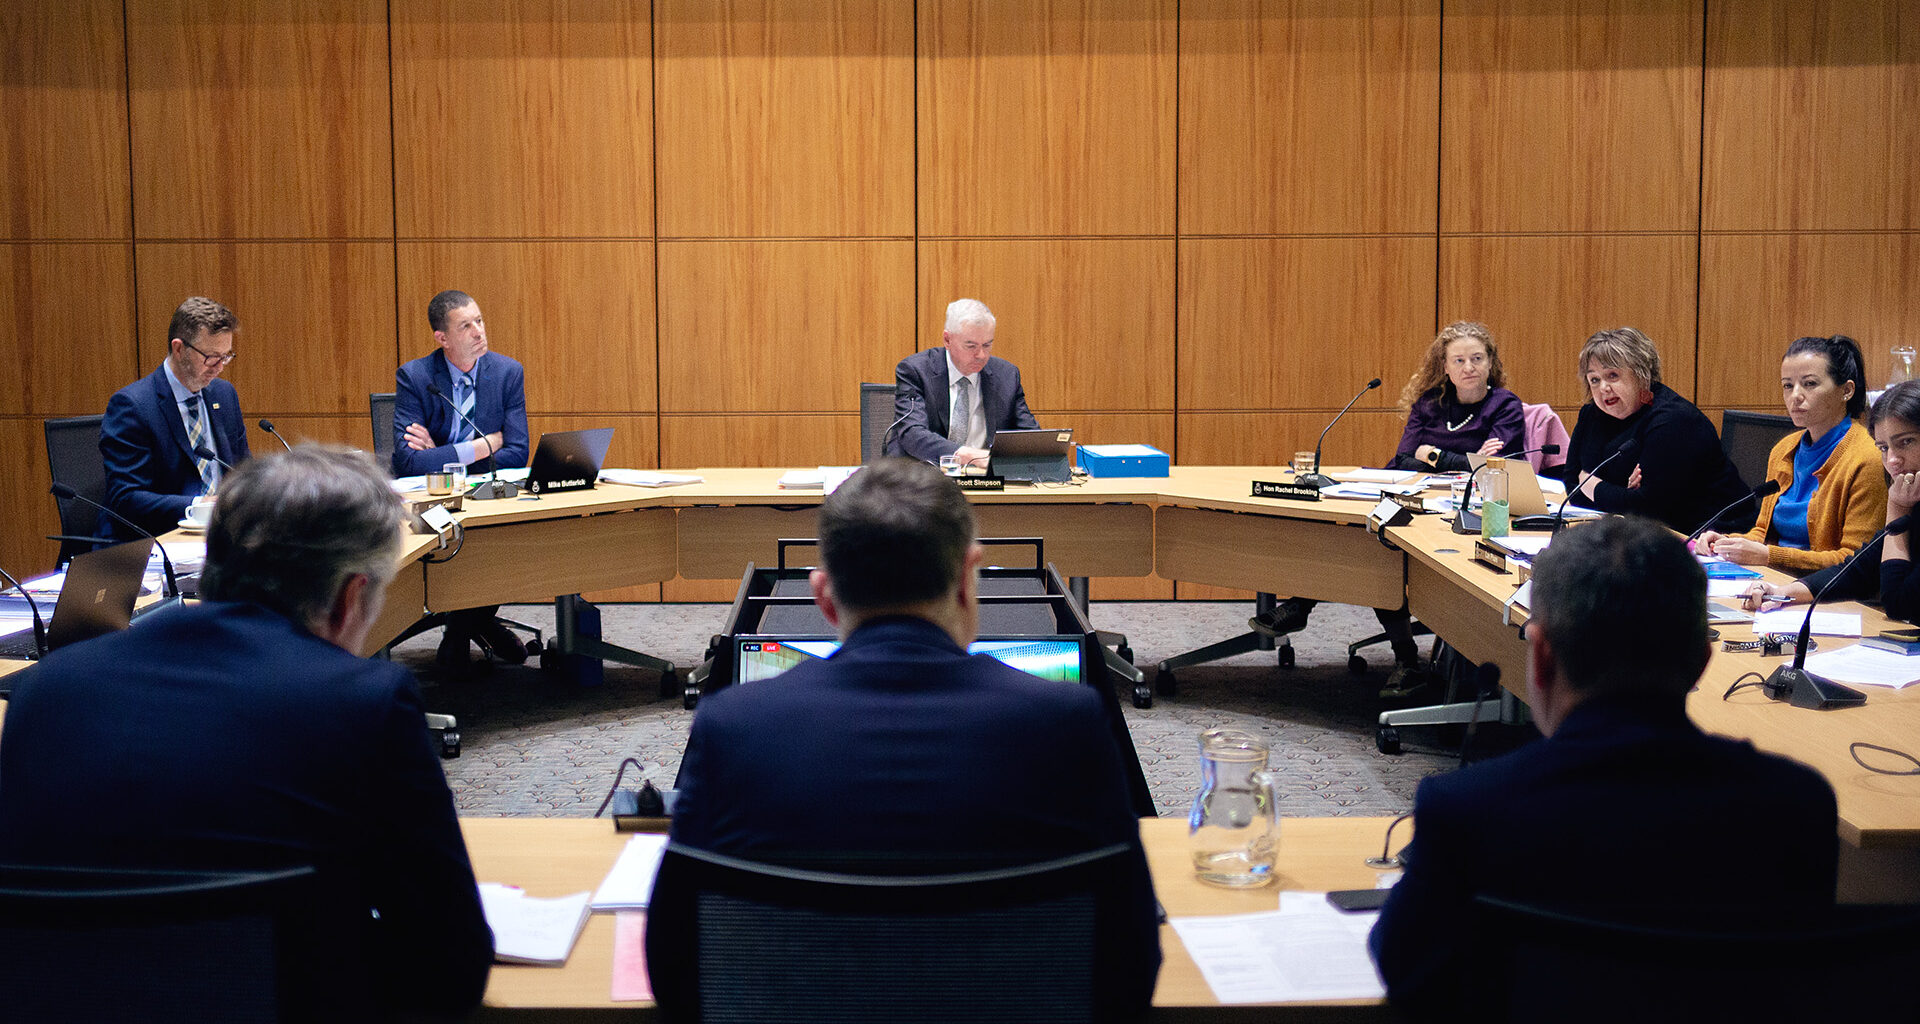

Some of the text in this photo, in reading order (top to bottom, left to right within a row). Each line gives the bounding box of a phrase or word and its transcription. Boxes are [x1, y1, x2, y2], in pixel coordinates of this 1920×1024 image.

[547, 478, 586, 489] Mike Butterick
[973, 479, 1001, 488] Simpson
[1263, 485, 1318, 498] Hon Rachel Brooking
[1780, 669, 1797, 681] AKG
